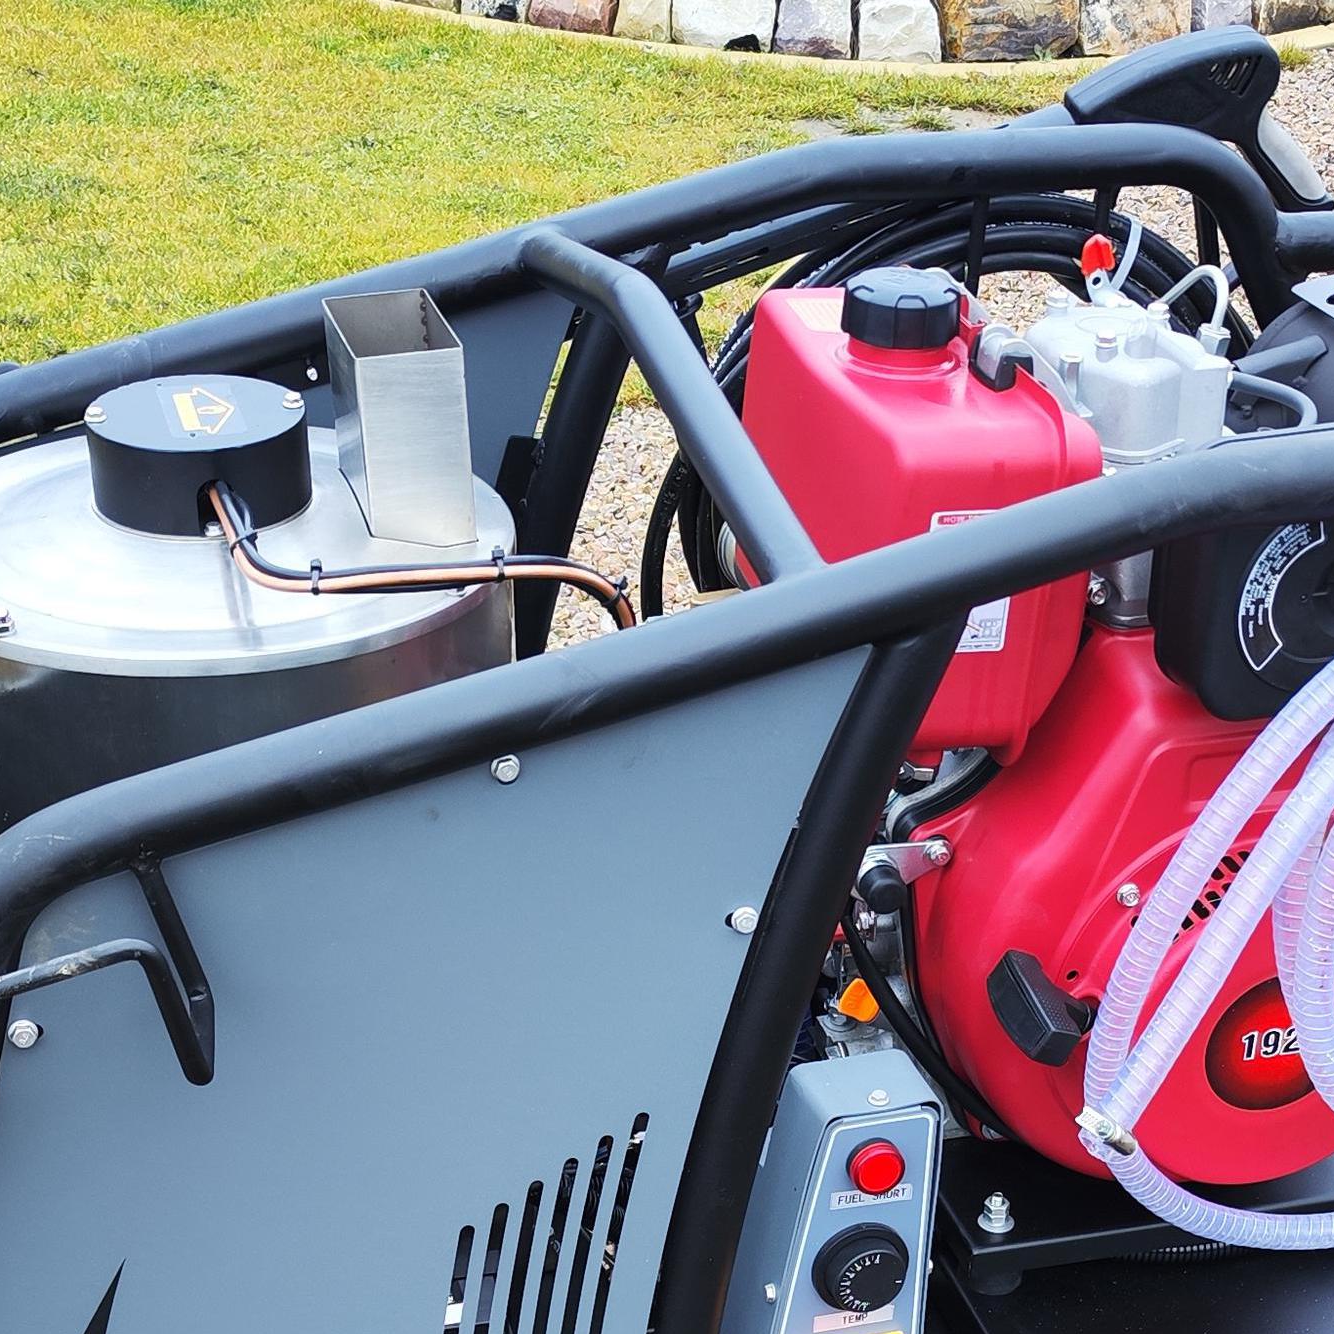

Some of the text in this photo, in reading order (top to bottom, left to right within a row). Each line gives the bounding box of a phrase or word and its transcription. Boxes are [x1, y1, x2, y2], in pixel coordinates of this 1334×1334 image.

[1242, 1024, 1301, 1061] 192
[837, 1193, 865, 1206] FUEL
[842, 1313, 868, 1325] TEMP
